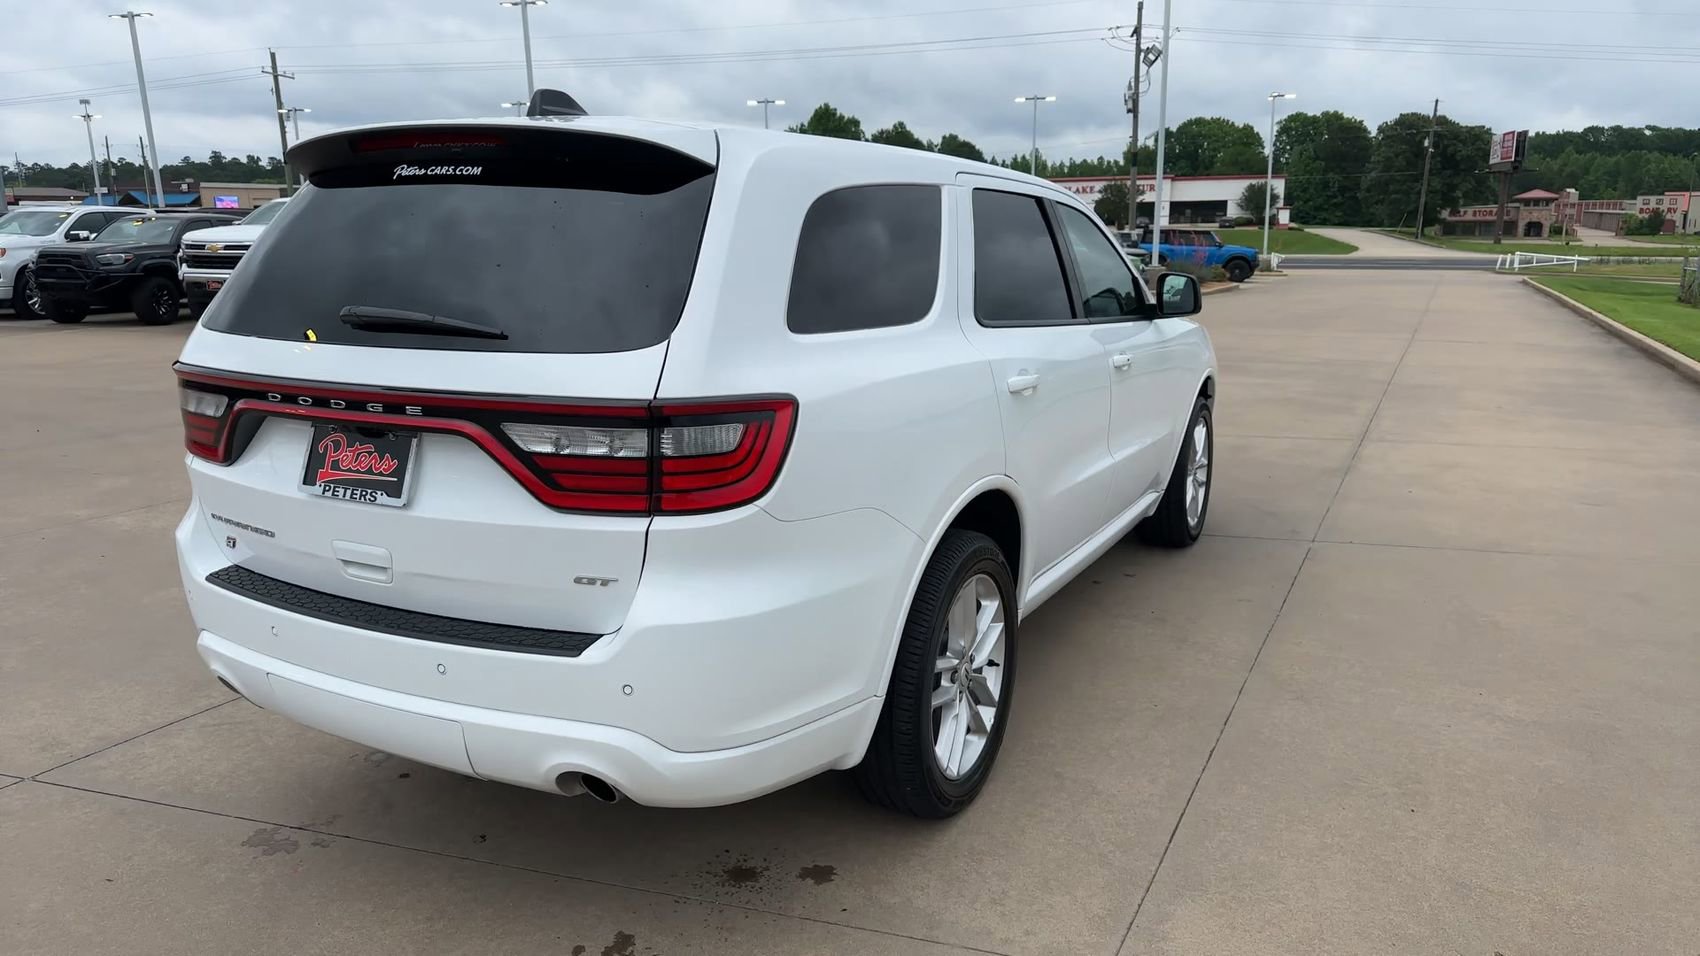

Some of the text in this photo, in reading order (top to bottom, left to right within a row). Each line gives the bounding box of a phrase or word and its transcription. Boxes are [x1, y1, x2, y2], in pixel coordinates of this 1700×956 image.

[393, 164, 483, 180] Peters CARS.COM
[267, 392, 424, 416] DODGE
[319, 432, 398, 475] Peters
[321, 484, 378, 503] PETERS
[573, 576, 619, 587] GT
